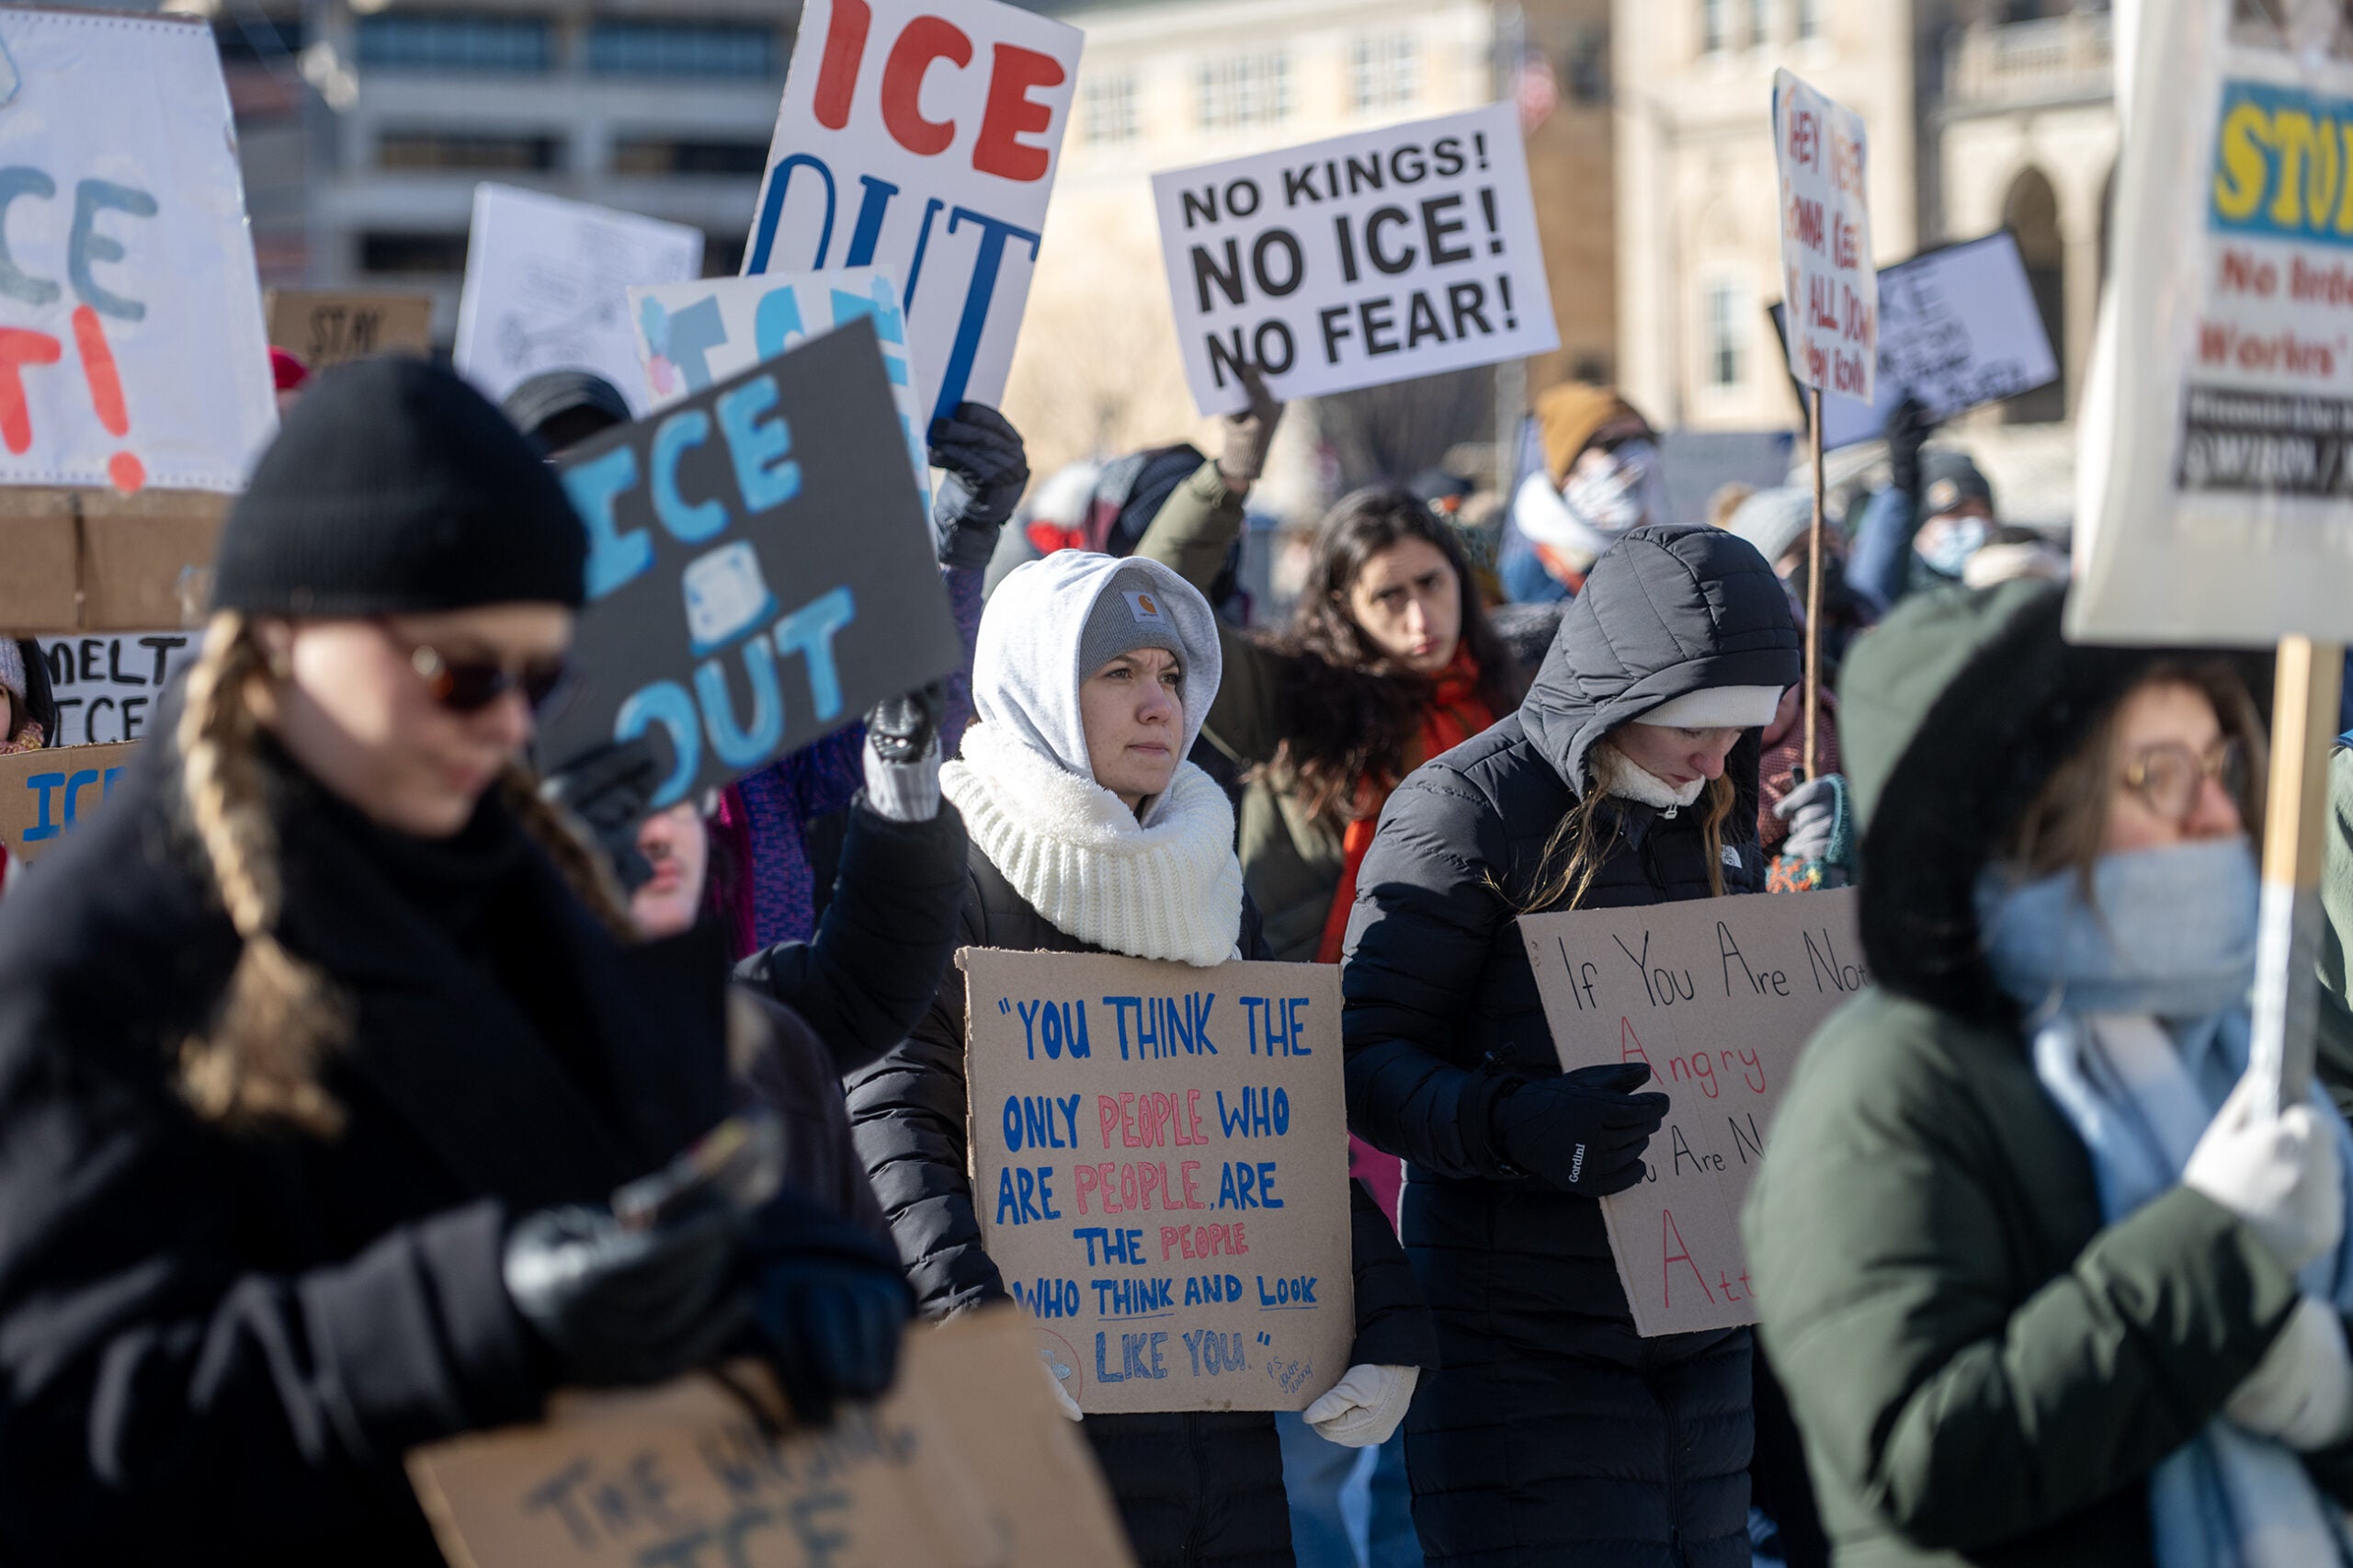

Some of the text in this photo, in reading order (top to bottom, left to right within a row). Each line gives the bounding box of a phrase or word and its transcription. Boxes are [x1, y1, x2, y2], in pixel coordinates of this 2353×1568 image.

[812, 0, 1066, 182] ICE
[1180, 130, 1491, 231] NO KINGS!
[1190, 186, 1506, 313] NO ICE!
[1206, 275, 1520, 390] NO FEAR!
[561, 372, 803, 601] ICE
[613, 585, 857, 810] OUT
[23, 767, 127, 842] IC
[1558, 921, 1868, 1011] If You Are Not
[1103, 992, 1219, 1061] THINK
[1239, 996, 1313, 1057] THE
[1620, 1016, 1767, 1099] Angry
[1003, 1085, 1290, 1153] ONLY PEOPLE WHO
[1671, 1124, 1726, 1176] Are
[996, 1166, 1062, 1226] ARE
[1218, 1161, 1285, 1210] ARE
[1568, 1142, 1586, 1184] Gordini
[1073, 1222, 1250, 1267] THE PEOPLE
[1013, 1274, 1319, 1319] WHO THINK AND LOOK
[1095, 1331, 1169, 1383] LIKE
